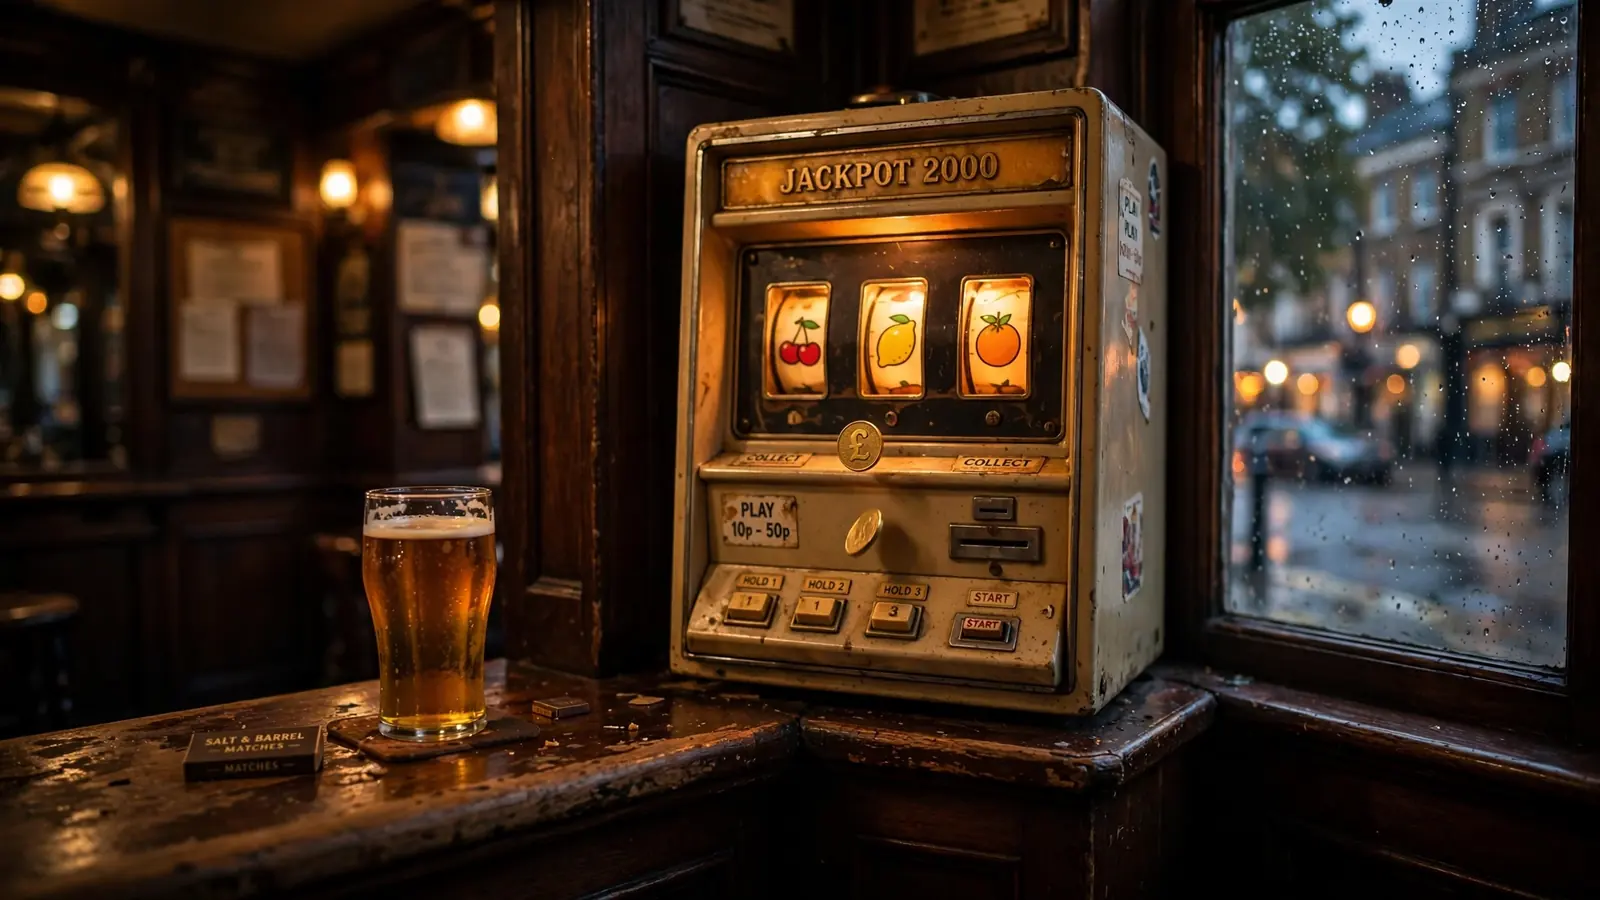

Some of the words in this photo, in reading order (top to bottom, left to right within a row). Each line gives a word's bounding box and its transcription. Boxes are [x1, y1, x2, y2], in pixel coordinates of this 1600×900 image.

[780, 158, 912, 194] JACKPOT
[922, 152, 999, 184] 2000
[746, 454, 803, 462] COLLECT
[963, 458, 1033, 467] COLLECT
[740, 502, 775, 518] PLAY
[731, 521, 752, 538] 10p
[766, 522, 790, 540] 50p
[743, 575, 769, 586] HOLD
[772, 578, 777, 587] 1
[808, 580, 835, 590] HOLD
[837, 582, 845, 591] 2
[883, 585, 912, 596] HOLD
[914, 587, 922, 596] 3
[746, 596, 752, 606] 1
[973, 592, 1010, 604] START
[814, 601, 820, 611] 1
[888, 605, 899, 617] 3
[966, 618, 998, 629] START
[205, 736, 237, 746] SALT
[240, 735, 249, 744] &
[255, 732, 305, 742] BARREL
[224, 743, 284, 753] MATCHES
[225, 761, 279, 773] MATCHES
